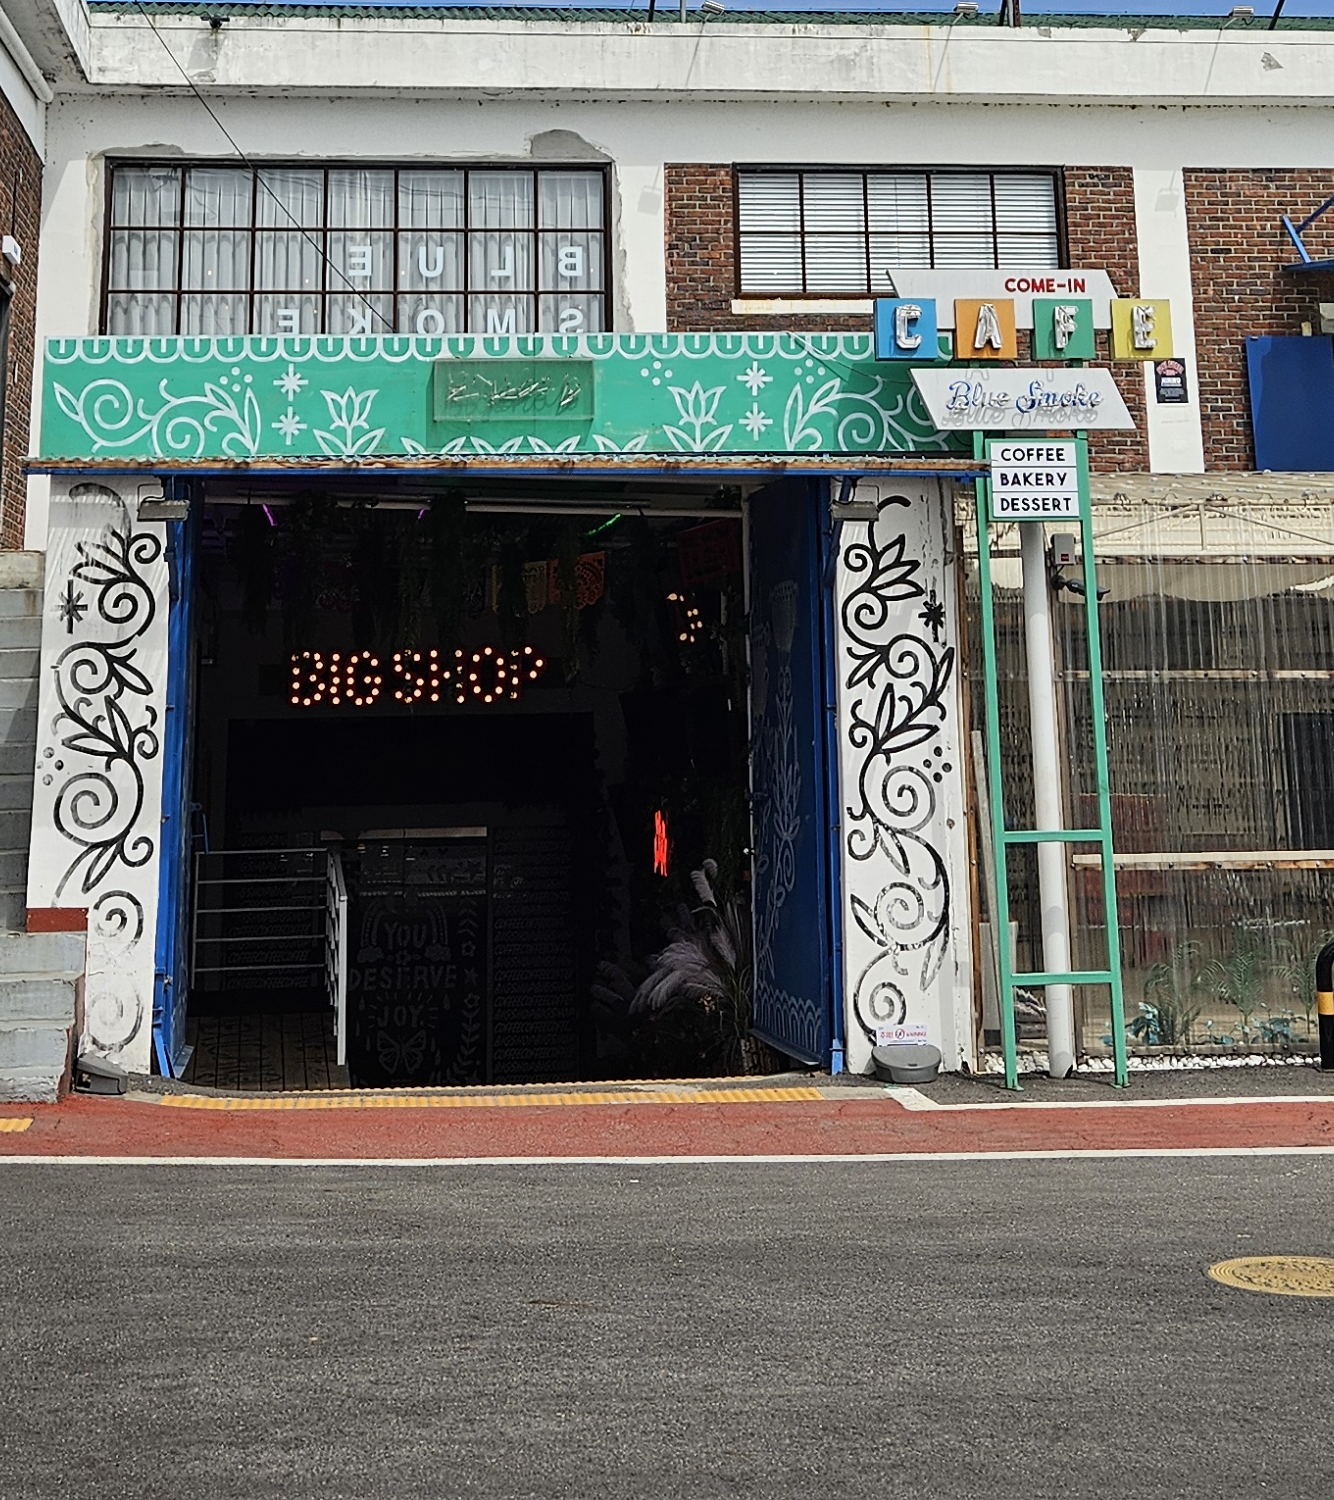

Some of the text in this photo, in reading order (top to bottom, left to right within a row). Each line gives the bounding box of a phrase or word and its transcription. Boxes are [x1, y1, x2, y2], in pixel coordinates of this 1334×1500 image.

[1004, 277, 1086, 293] COME-IN
[894, 303, 1158, 350] CAFE
[945, 379, 1104, 414] Blue Smoke
[1000, 447, 1066, 462] COFFEE
[999, 472, 1068, 487] BAKERY
[999, 497, 1072, 512] DESSERT
[384, 921, 427, 951] YOU
